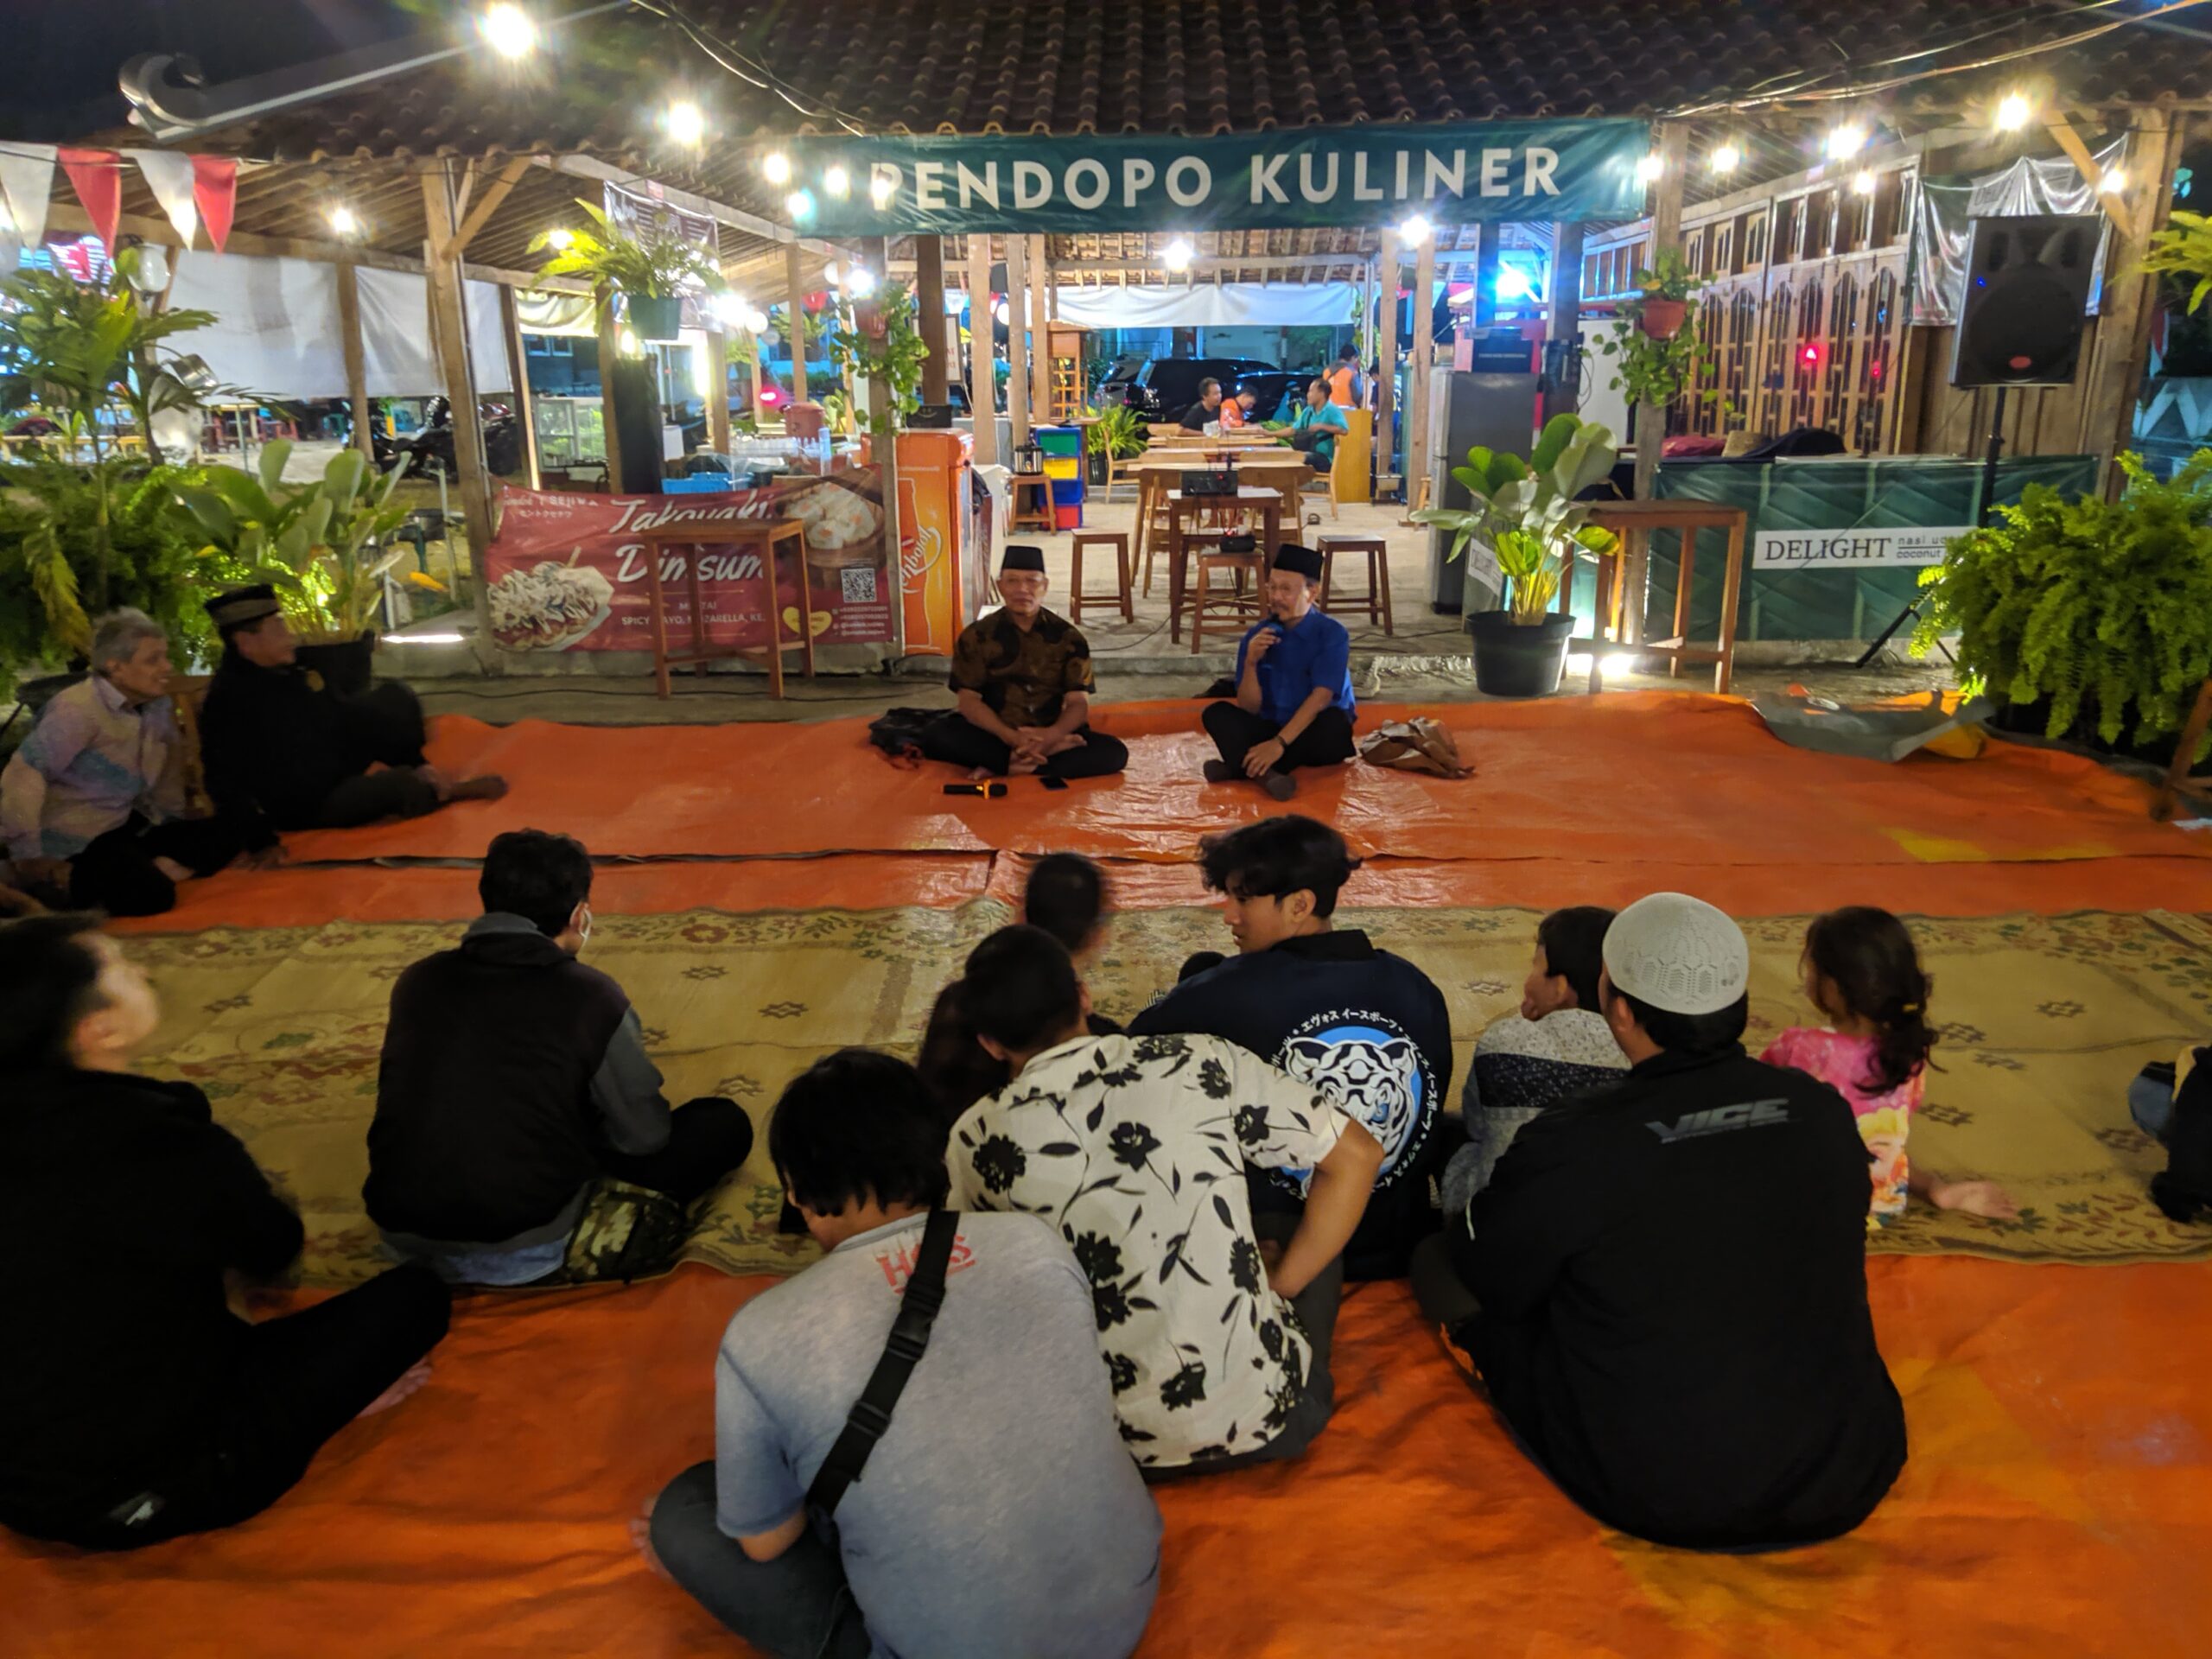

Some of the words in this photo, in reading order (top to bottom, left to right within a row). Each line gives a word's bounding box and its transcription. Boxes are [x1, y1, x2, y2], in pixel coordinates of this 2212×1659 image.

[870, 156, 1212, 211] PENDOPO
[1250, 147, 1561, 205] KULINER
[1765, 537, 1891, 560] DELIGHT
[1898, 537, 1927, 546] nasi
[1897, 548, 1941, 560] coconut
[621, 616, 650, 626] SPICY
[663, 614, 685, 626] AYO,
[1644, 1098, 1789, 1139] VICE
